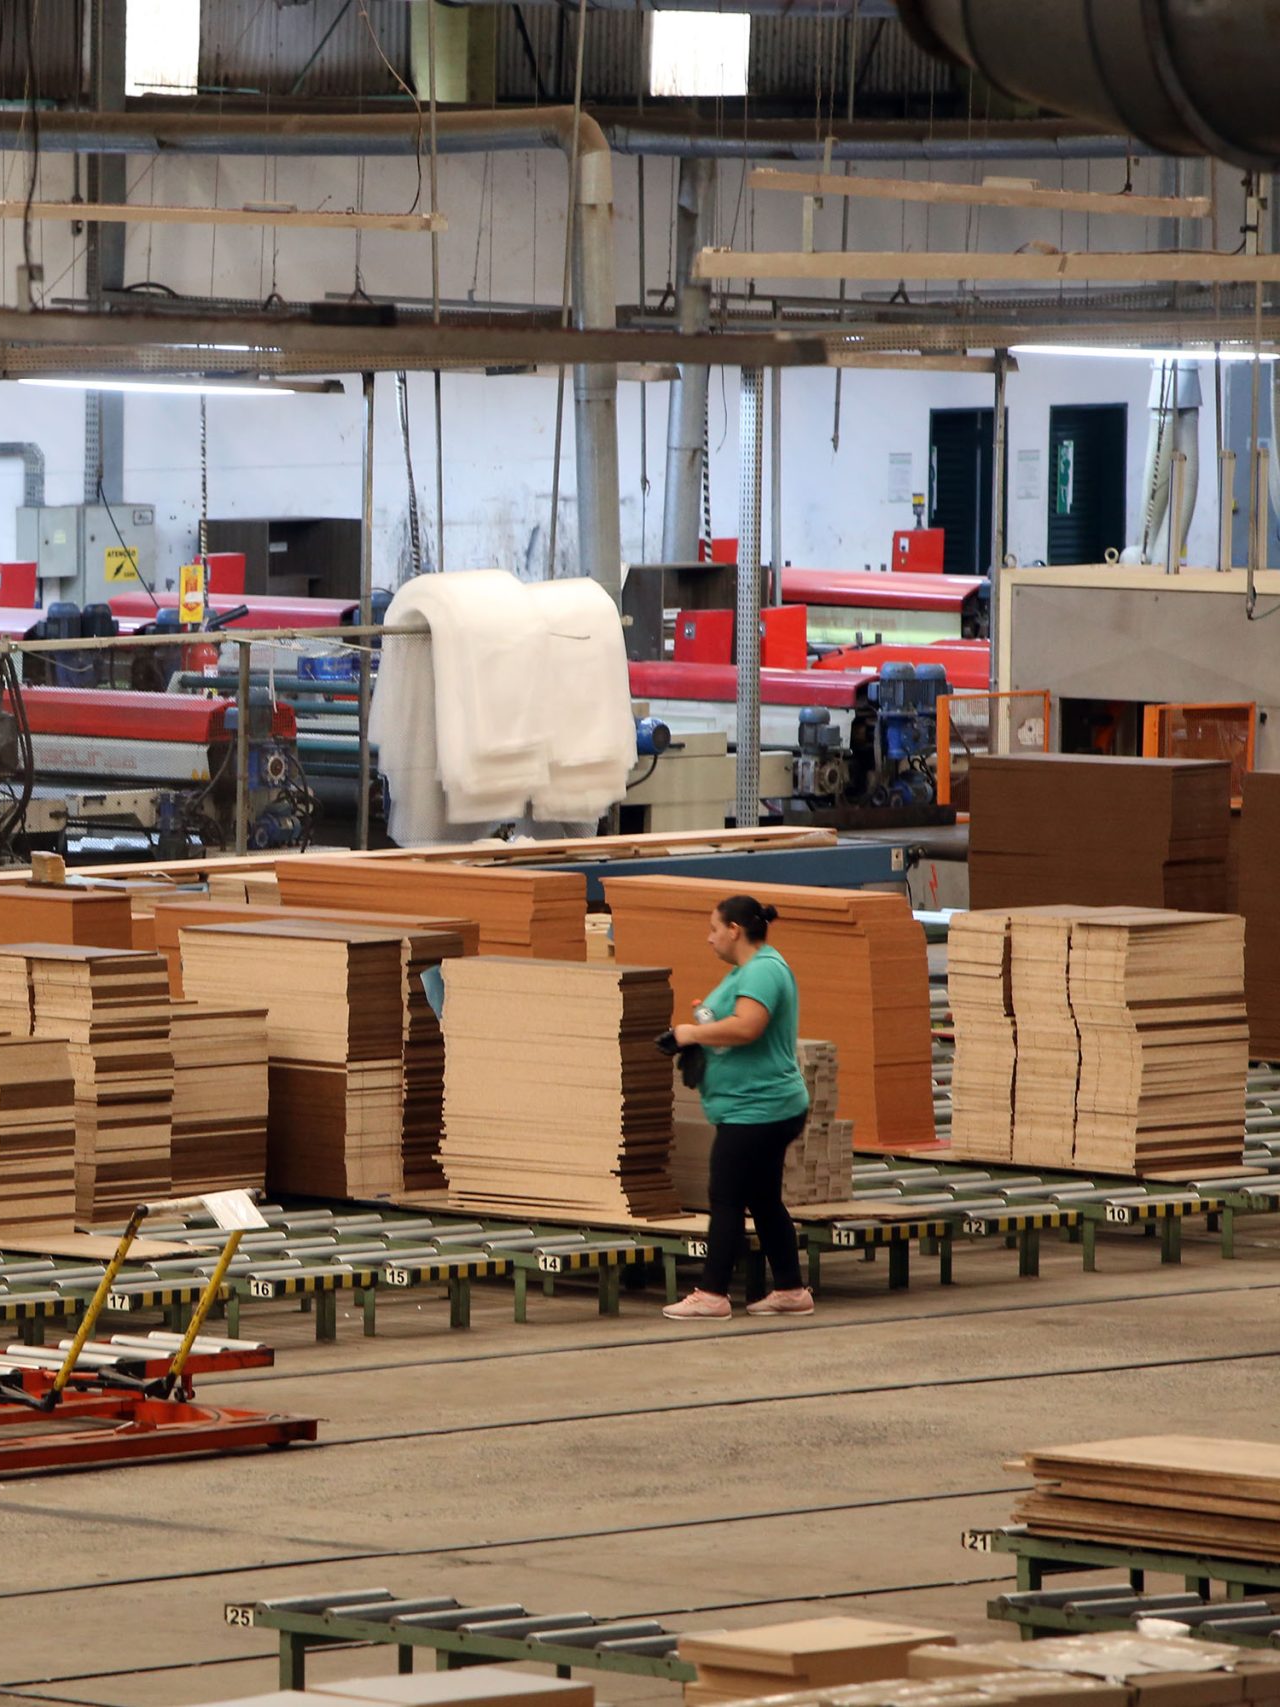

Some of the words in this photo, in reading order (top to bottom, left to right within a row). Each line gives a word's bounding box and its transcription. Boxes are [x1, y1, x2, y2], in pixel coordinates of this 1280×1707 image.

[1109, 1208, 1125, 1221] 10
[967, 1220, 982, 1233] 12
[836, 1230, 850, 1244] 11
[691, 1242, 706, 1256] 13
[541, 1257, 557, 1270] 14
[389, 1270, 404, 1284] 15
[253, 1282, 269, 1296] 16
[110, 1295, 126, 1309] 17
[969, 1533, 987, 1551] 21
[230, 1608, 250, 1626] 25
